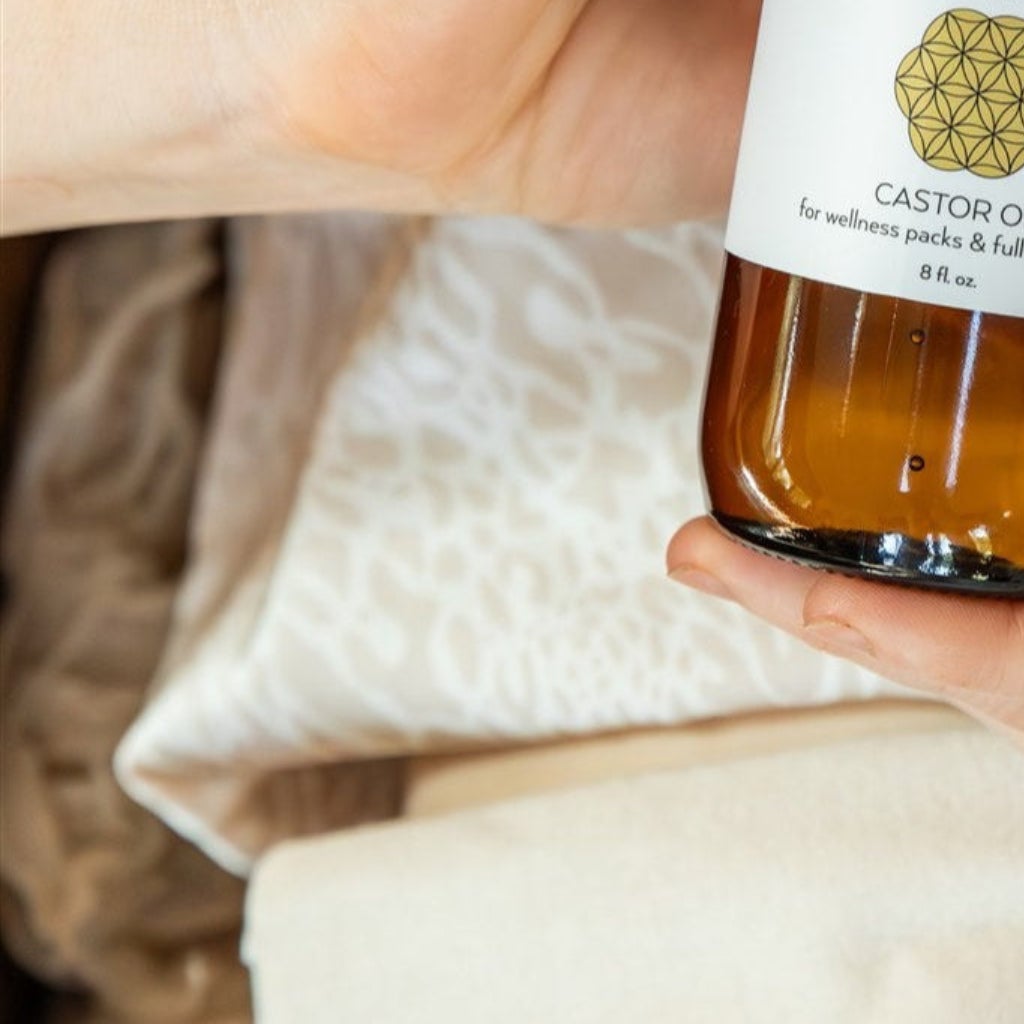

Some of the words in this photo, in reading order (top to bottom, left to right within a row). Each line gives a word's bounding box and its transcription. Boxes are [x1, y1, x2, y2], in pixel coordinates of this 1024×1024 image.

[875, 182, 992, 223] CASTOR
[799, 196, 821, 220] for
[825, 208, 900, 238] wellness
[904, 226, 963, 249] packs
[969, 232, 986, 252] &
[992, 234, 1024, 259] full
[919, 264, 932, 280] 8
[936, 265, 951, 284] fl.
[955, 274, 977, 288] oz.
